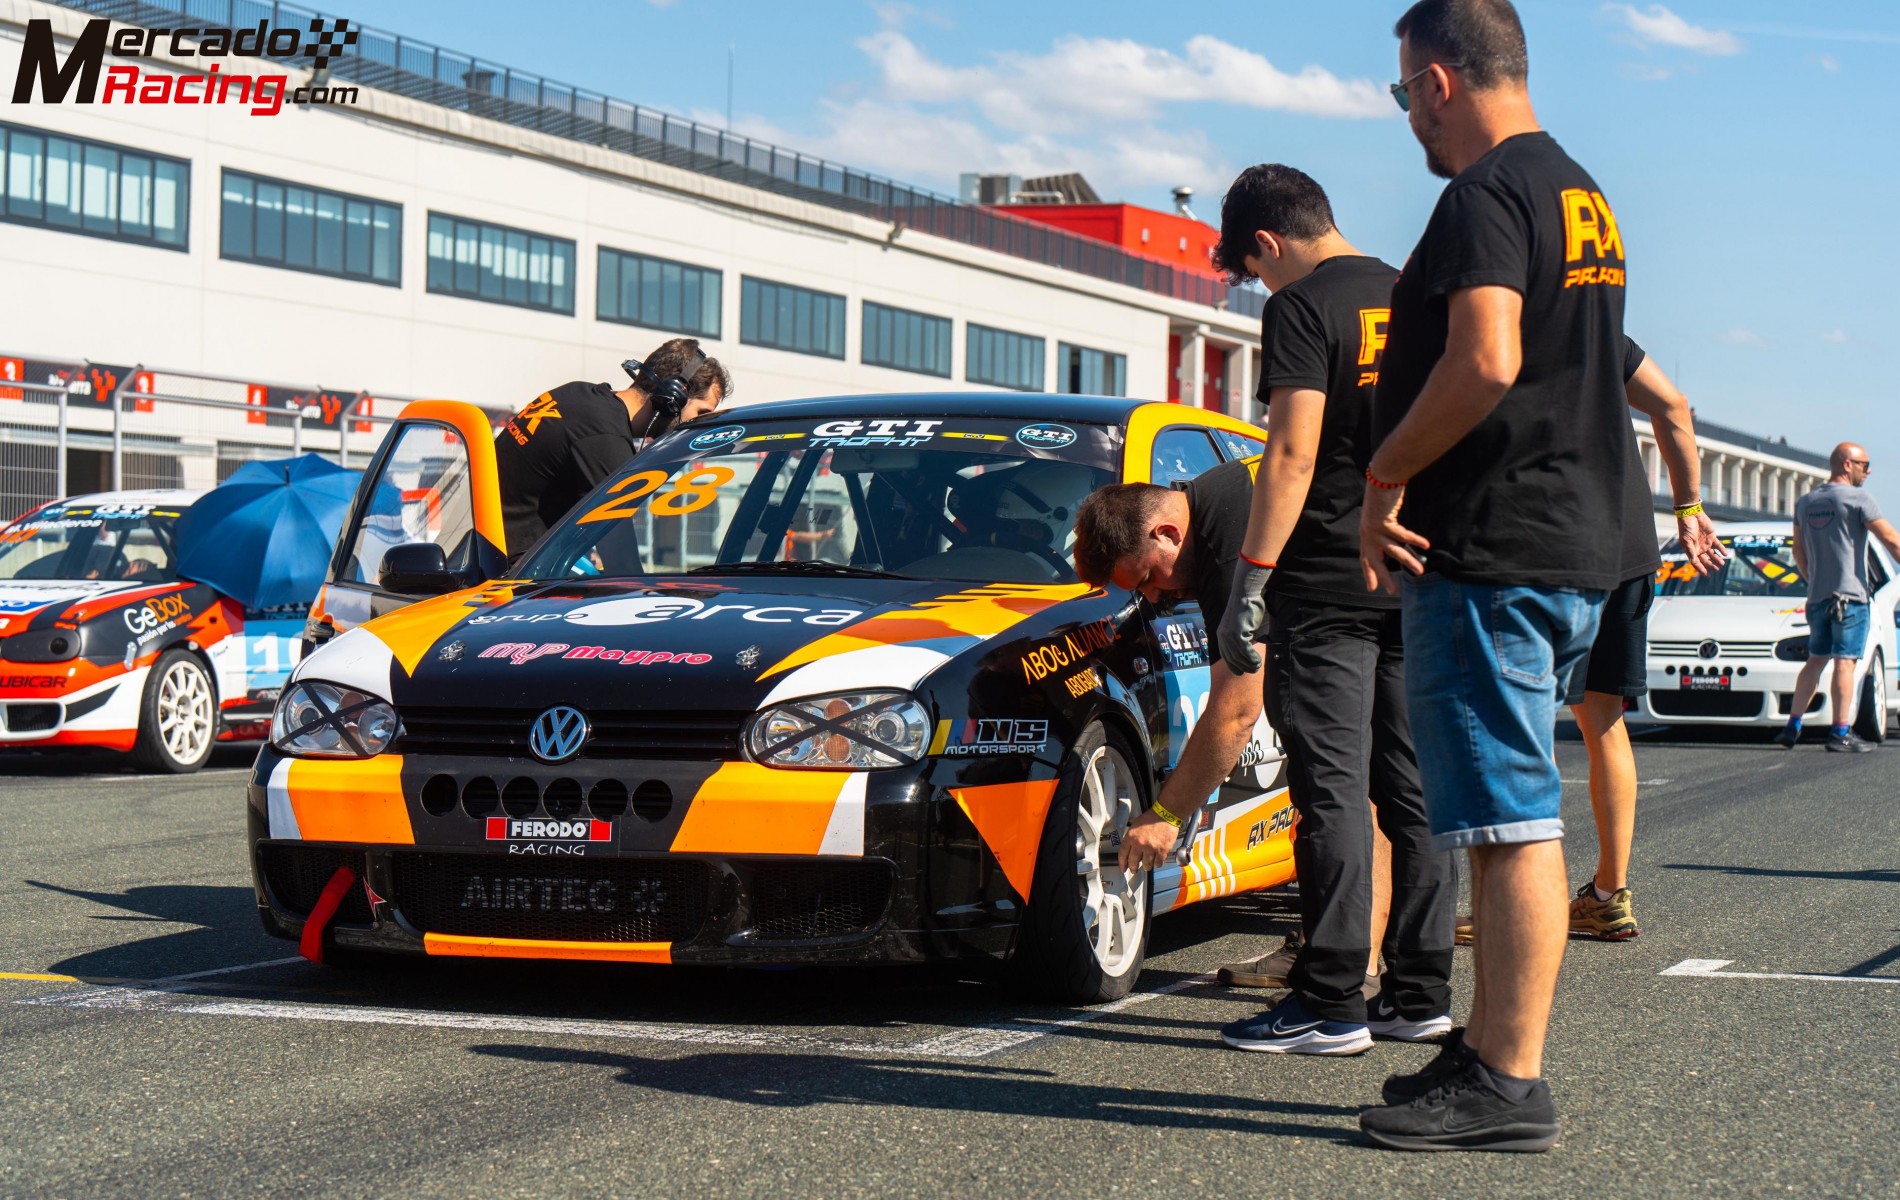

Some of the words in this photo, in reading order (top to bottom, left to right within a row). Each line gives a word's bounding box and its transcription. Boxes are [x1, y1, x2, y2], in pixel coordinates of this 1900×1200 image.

[813, 420, 943, 437] GTI
[1021, 428, 1073, 441] GTI
[808, 436, 932, 447] TROPHY
[576, 466, 735, 525] 28
[468, 612, 588, 625] grupo
[1166, 622, 1200, 650] GTI
[944, 744, 1047, 755] MOTORSPORT
[511, 821, 588, 838] FERODO
[509, 843, 586, 856] RACING
[460, 876, 616, 911] AIRTEC
